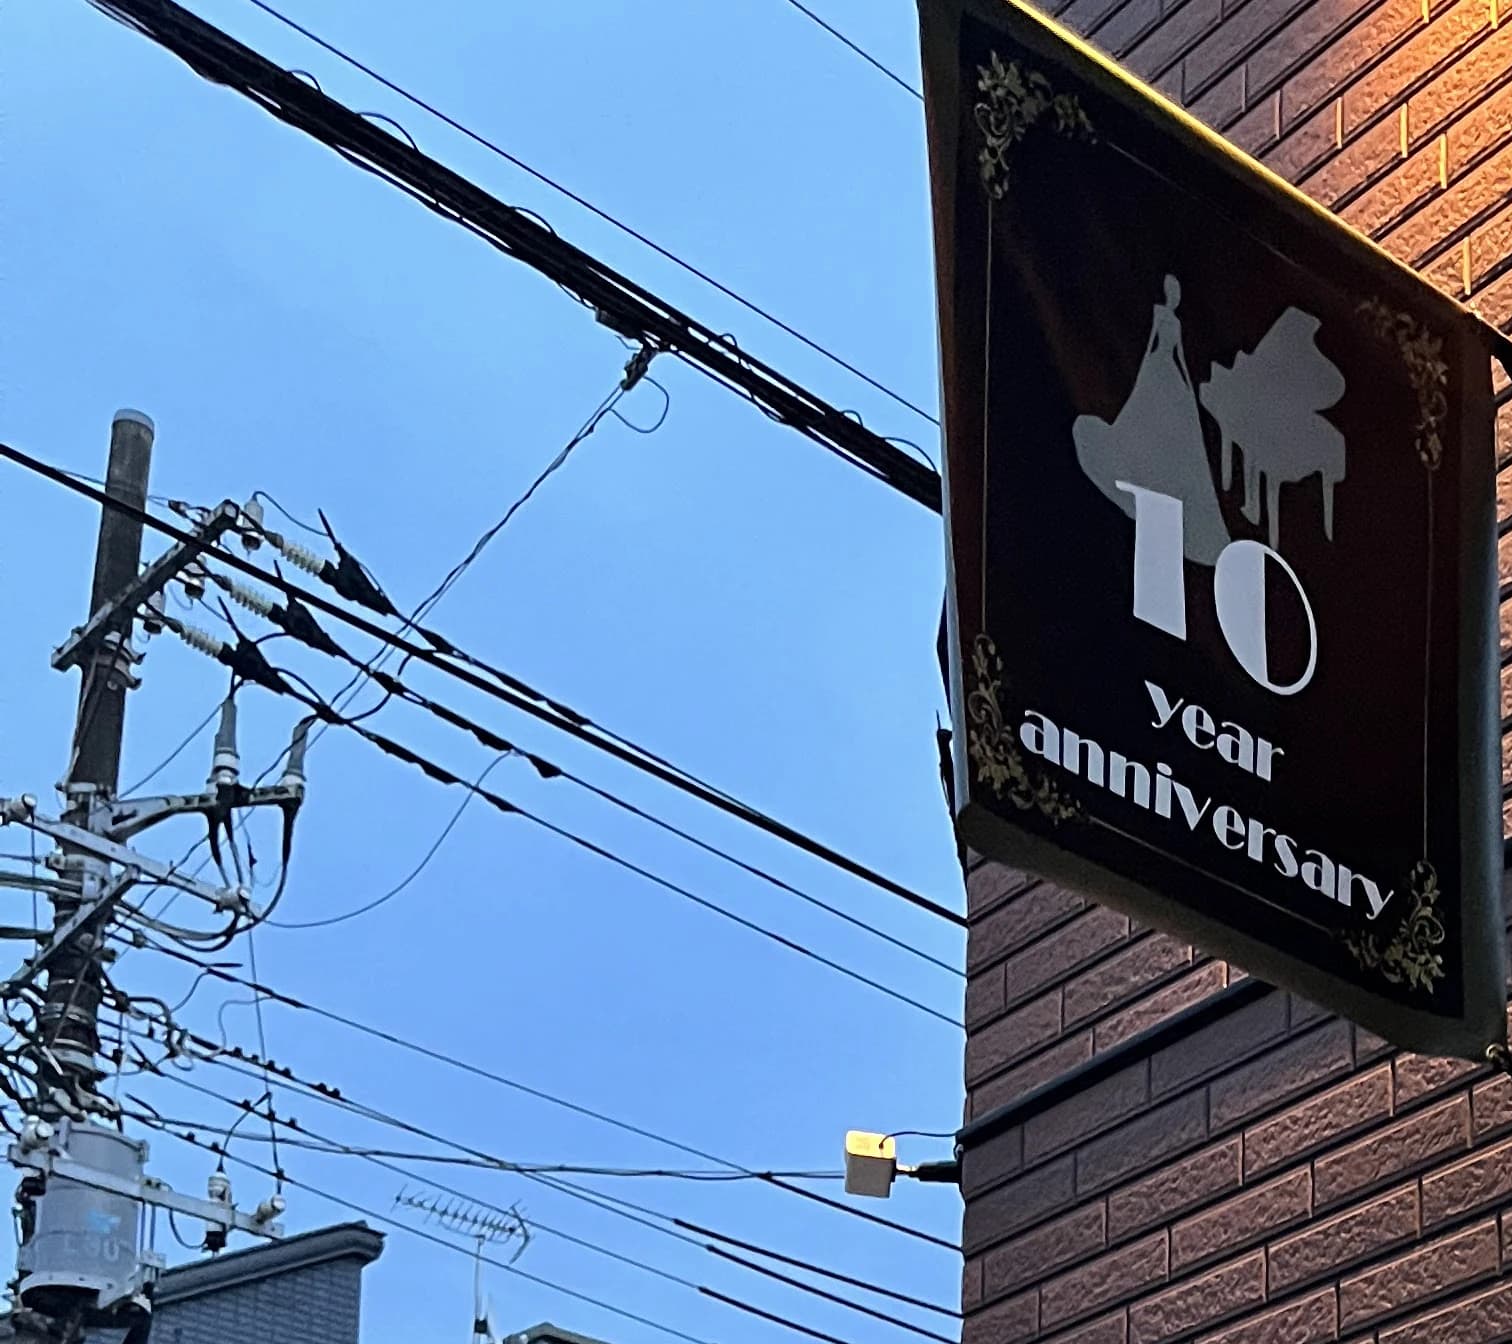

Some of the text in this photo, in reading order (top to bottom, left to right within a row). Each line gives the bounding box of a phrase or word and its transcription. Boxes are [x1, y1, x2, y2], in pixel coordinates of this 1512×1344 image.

[1115, 479, 1318, 697] 10
[1020, 709, 1395, 920] anniversary
[1144, 679, 1284, 783] year
